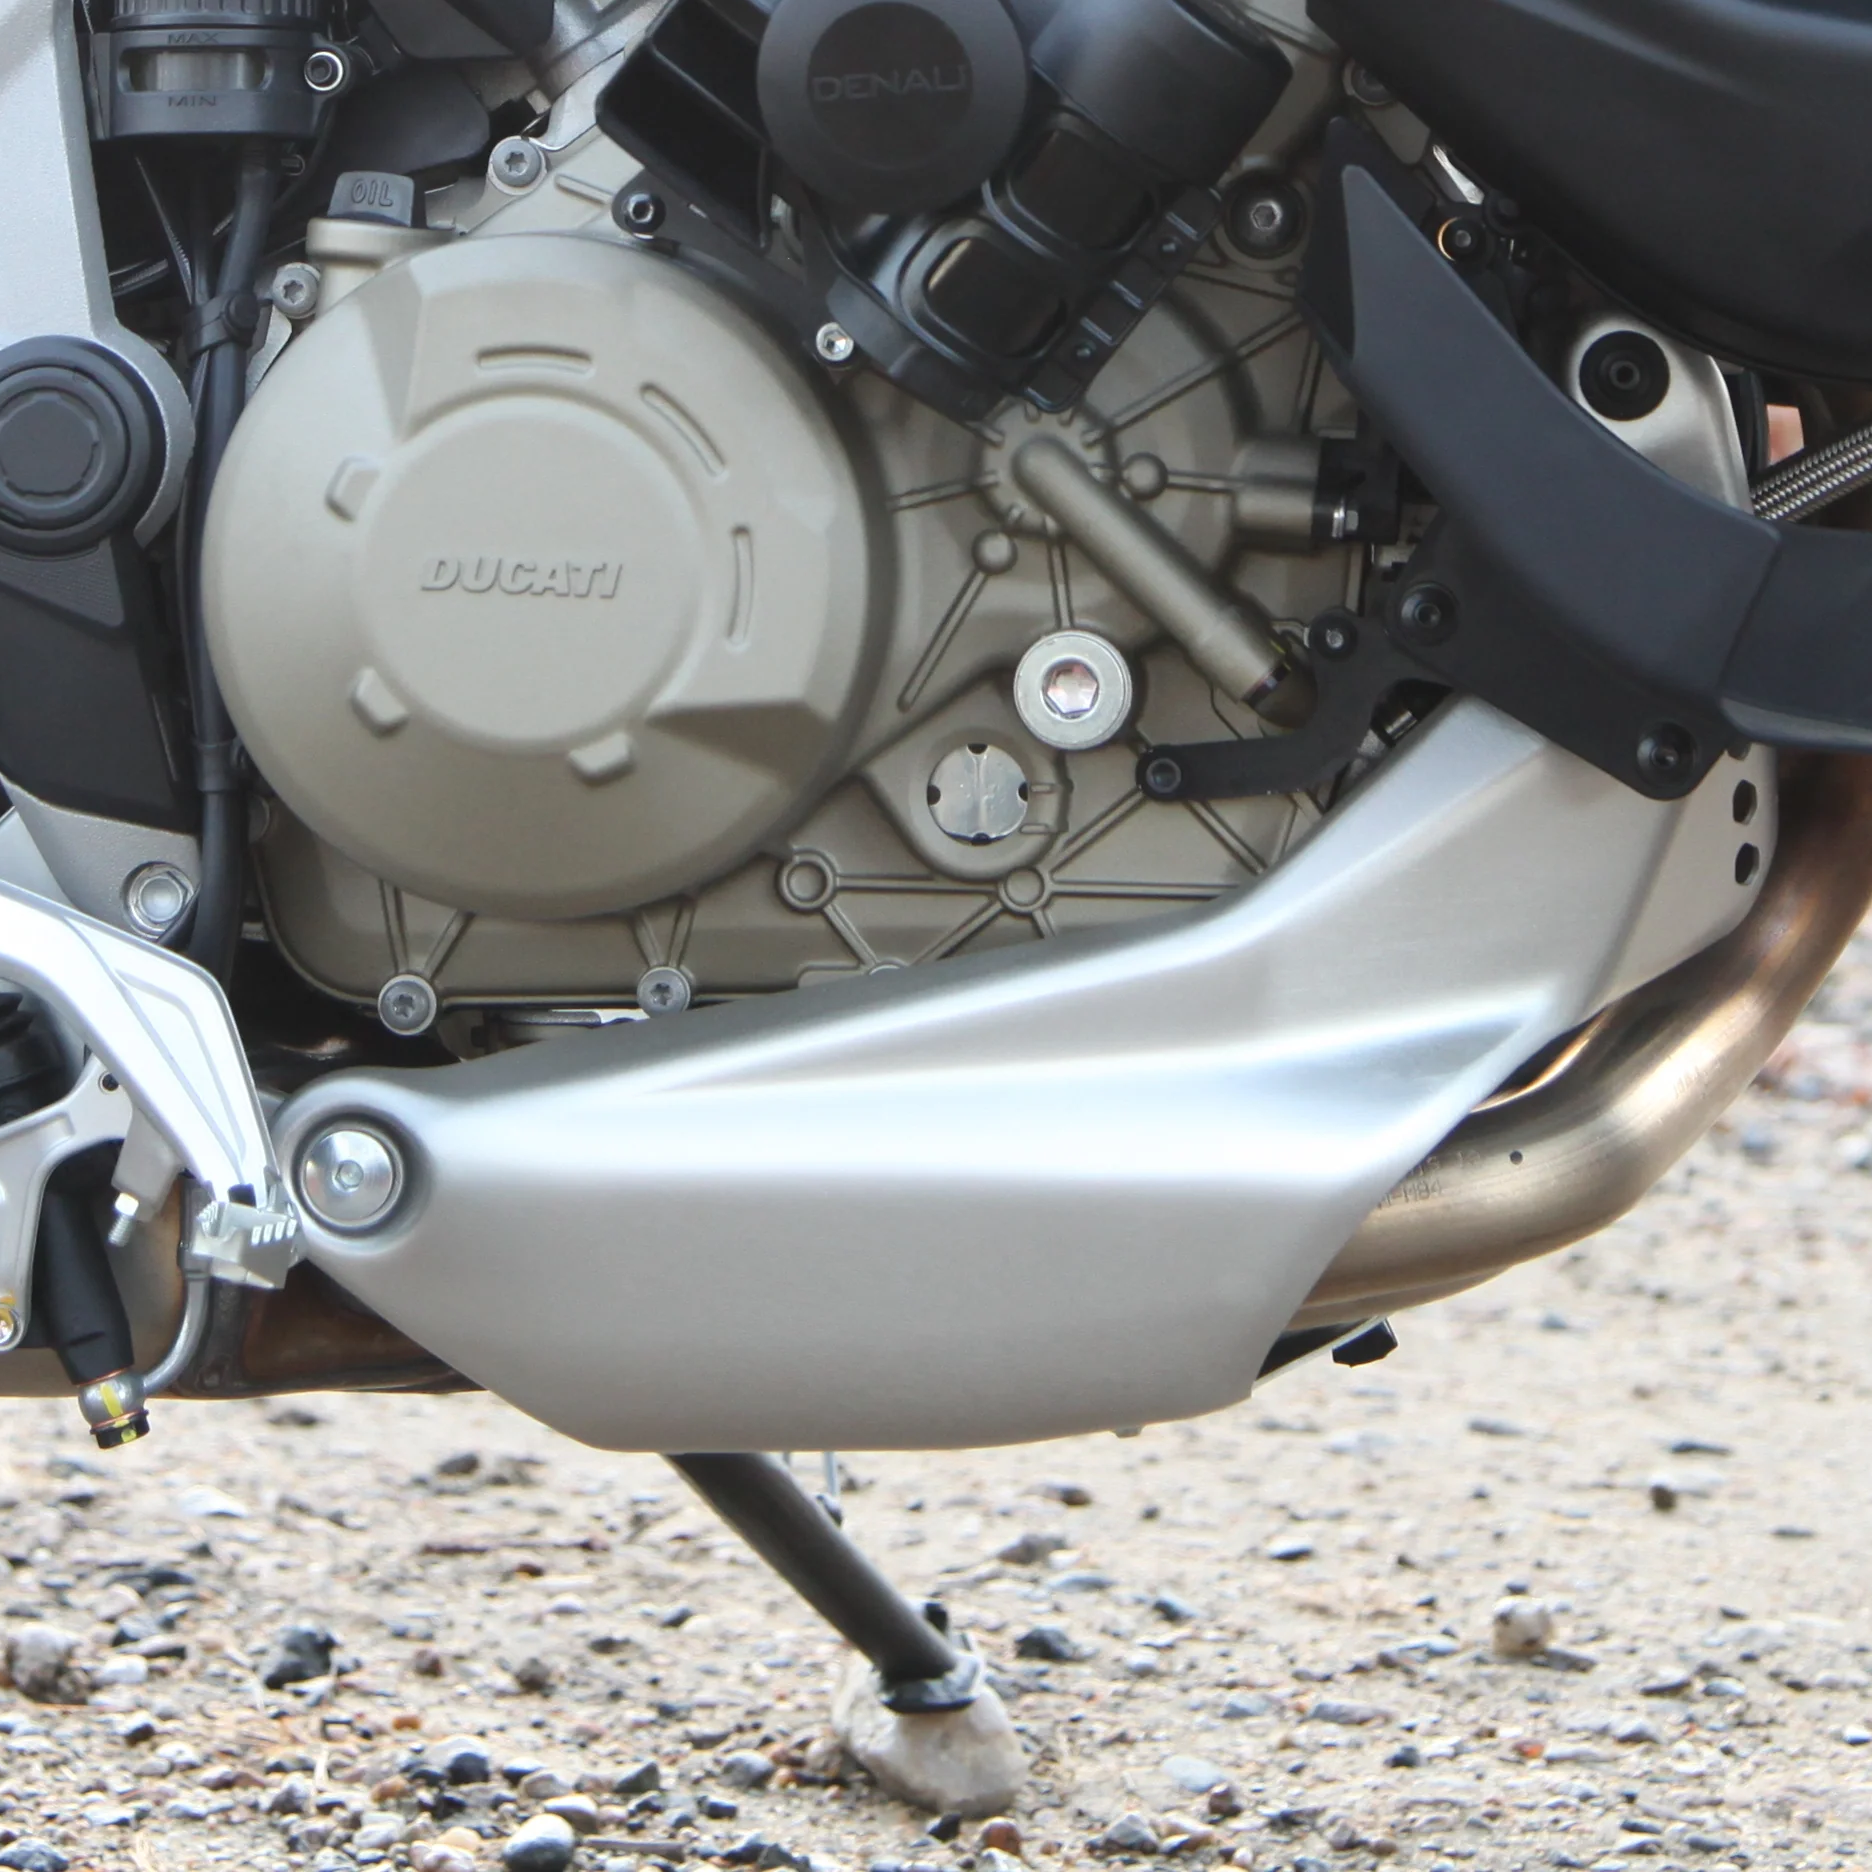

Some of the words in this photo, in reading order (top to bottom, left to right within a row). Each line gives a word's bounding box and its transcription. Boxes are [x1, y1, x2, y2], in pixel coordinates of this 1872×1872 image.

[168, 32, 220, 45] MAX
[812, 65, 966, 101] DENALI
[168, 95, 217, 108] MIN
[350, 177, 394, 207] OIL
[419, 555, 623, 599] DUCATI
